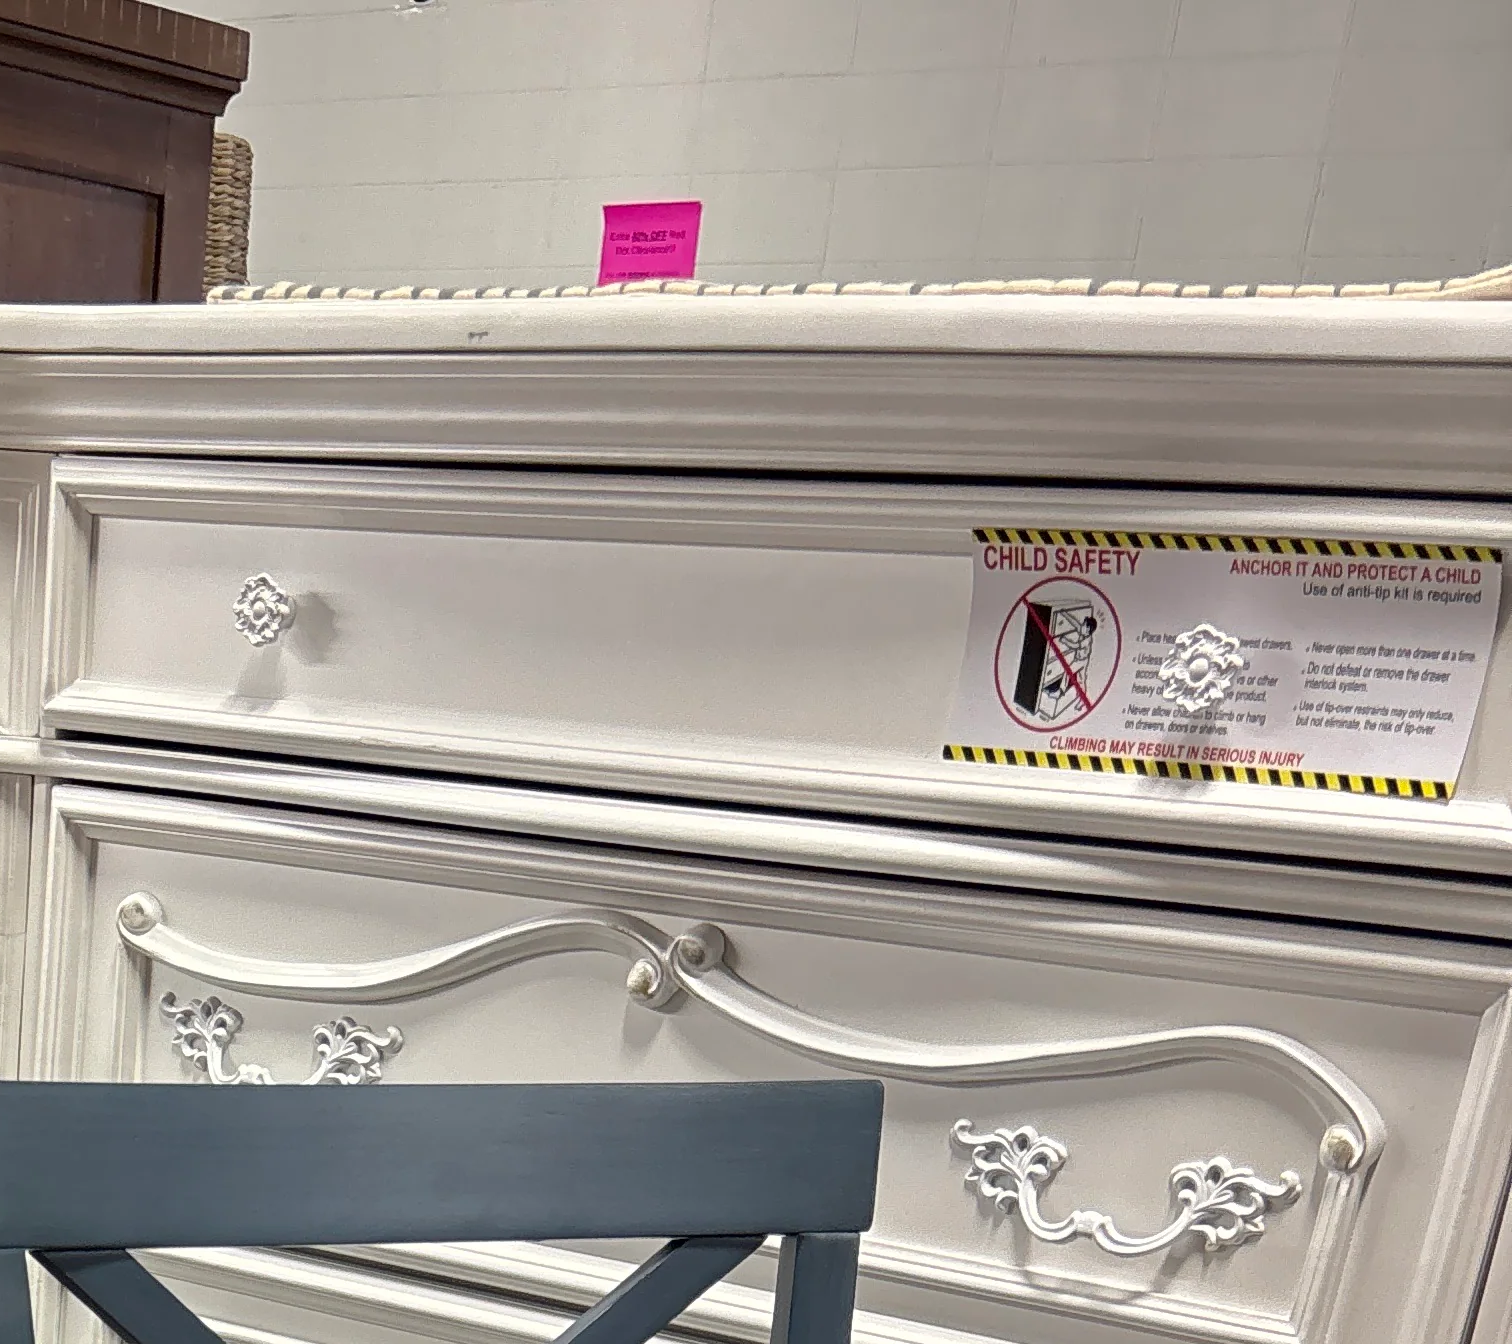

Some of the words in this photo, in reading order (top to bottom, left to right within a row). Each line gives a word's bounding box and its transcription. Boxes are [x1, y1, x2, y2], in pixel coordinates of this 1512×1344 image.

[984, 546, 1048, 571] CHILD
[1055, 548, 1140, 575] SAFETY
[1230, 559, 1291, 576] ANCHOR
[1296, 562, 1308, 577] IT
[1311, 562, 1342, 578] AND
[1348, 563, 1417, 581] PROTECT
[1420, 567, 1432, 582] A
[1436, 567, 1481, 585] CHILD
[1303, 582, 1327, 596] Use
[1331, 584, 1345, 597] of
[1347, 585, 1390, 601] anti-tip
[1394, 586, 1408, 599] kit
[1413, 587, 1423, 601] is
[1428, 589, 1482, 606] required
[1142, 631, 1161, 643] Place
[1240, 638, 1260, 648] owest
[1312, 642, 1335, 653] Never
[1138, 653, 1162, 665] Unless
[1307, 661, 1319, 674] Do
[1322, 663, 1334, 675] not
[1336, 663, 1361, 676] defeat
[1363, 667, 1372, 678] or
[1374, 668, 1404, 680] remove
[1406, 668, 1419, 681] the
[1421, 669, 1450, 682] drawer
[1247, 676, 1255, 686] or
[1257, 675, 1278, 687] other
[1304, 678, 1336, 690] interlock
[1132, 684, 1155, 698] heavy
[1127, 704, 1149, 716] Never
[1151, 706, 1170, 717] allow
[1205, 710, 1212, 720] to
[1236, 713, 1244, 722] or
[1247, 712, 1266, 726] hang
[1299, 700, 1314, 712] Use
[1316, 701, 1324, 712] of
[1391, 707, 1407, 719] may
[1408, 708, 1424, 722] only
[1125, 720, 1134, 729] on
[1190, 724, 1198, 734] or
[1296, 715, 1308, 726] but
[1310, 716, 1323, 727] not
[1364, 720, 1377, 731] the
[1378, 720, 1392, 732] risk
[1394, 721, 1404, 733] of
[1050, 736, 1106, 751] CLIMBING
[1110, 741, 1135, 755] MAY
[1138, 743, 1185, 758] RESULT
[1187, 746, 1200, 759] IN
[1202, 747, 1255, 764] SERIOUS
[1259, 752, 1305, 767] INJURY
